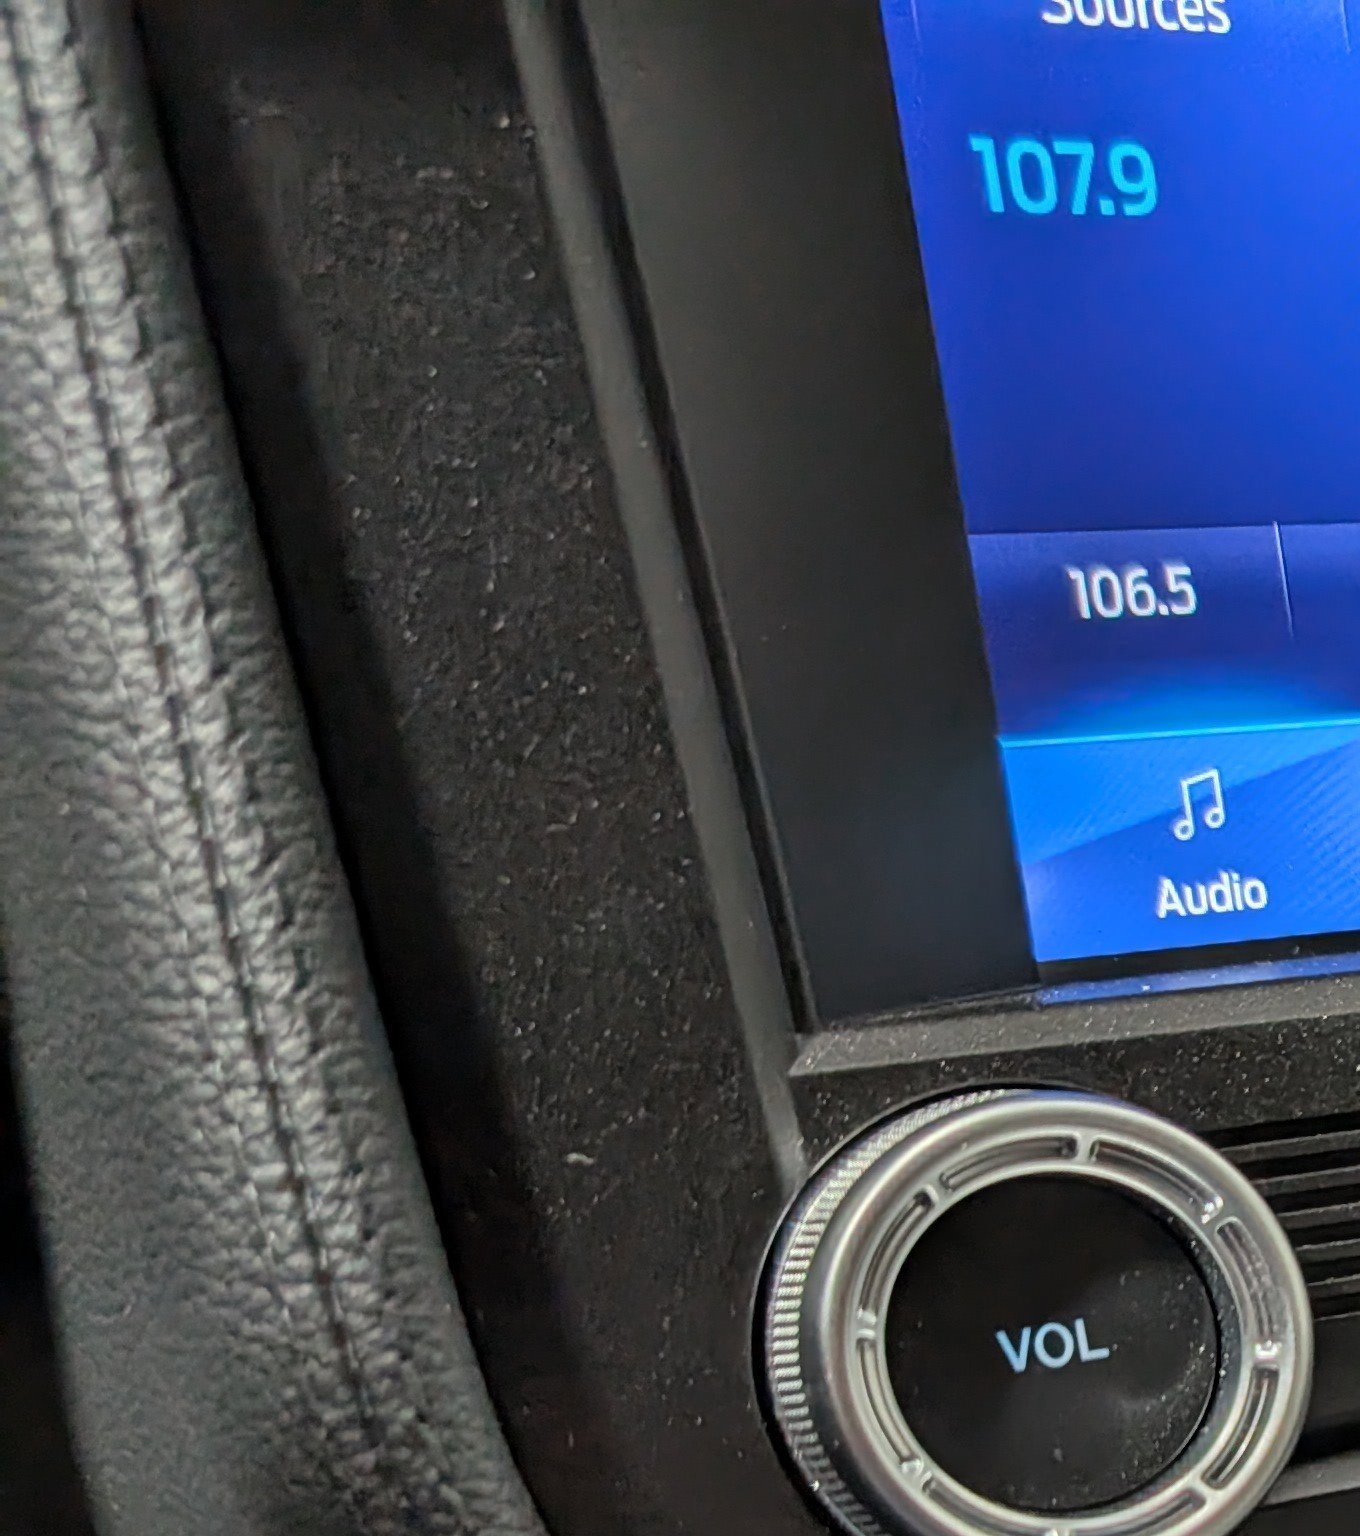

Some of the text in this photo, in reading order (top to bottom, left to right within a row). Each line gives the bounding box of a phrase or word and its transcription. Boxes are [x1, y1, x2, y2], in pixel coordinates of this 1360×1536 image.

[969, 134, 1158, 216] 107.9
[1064, 564, 1198, 619] 106.5
[1155, 872, 1268, 919] Audio
[994, 1317, 1111, 1374] VOL
